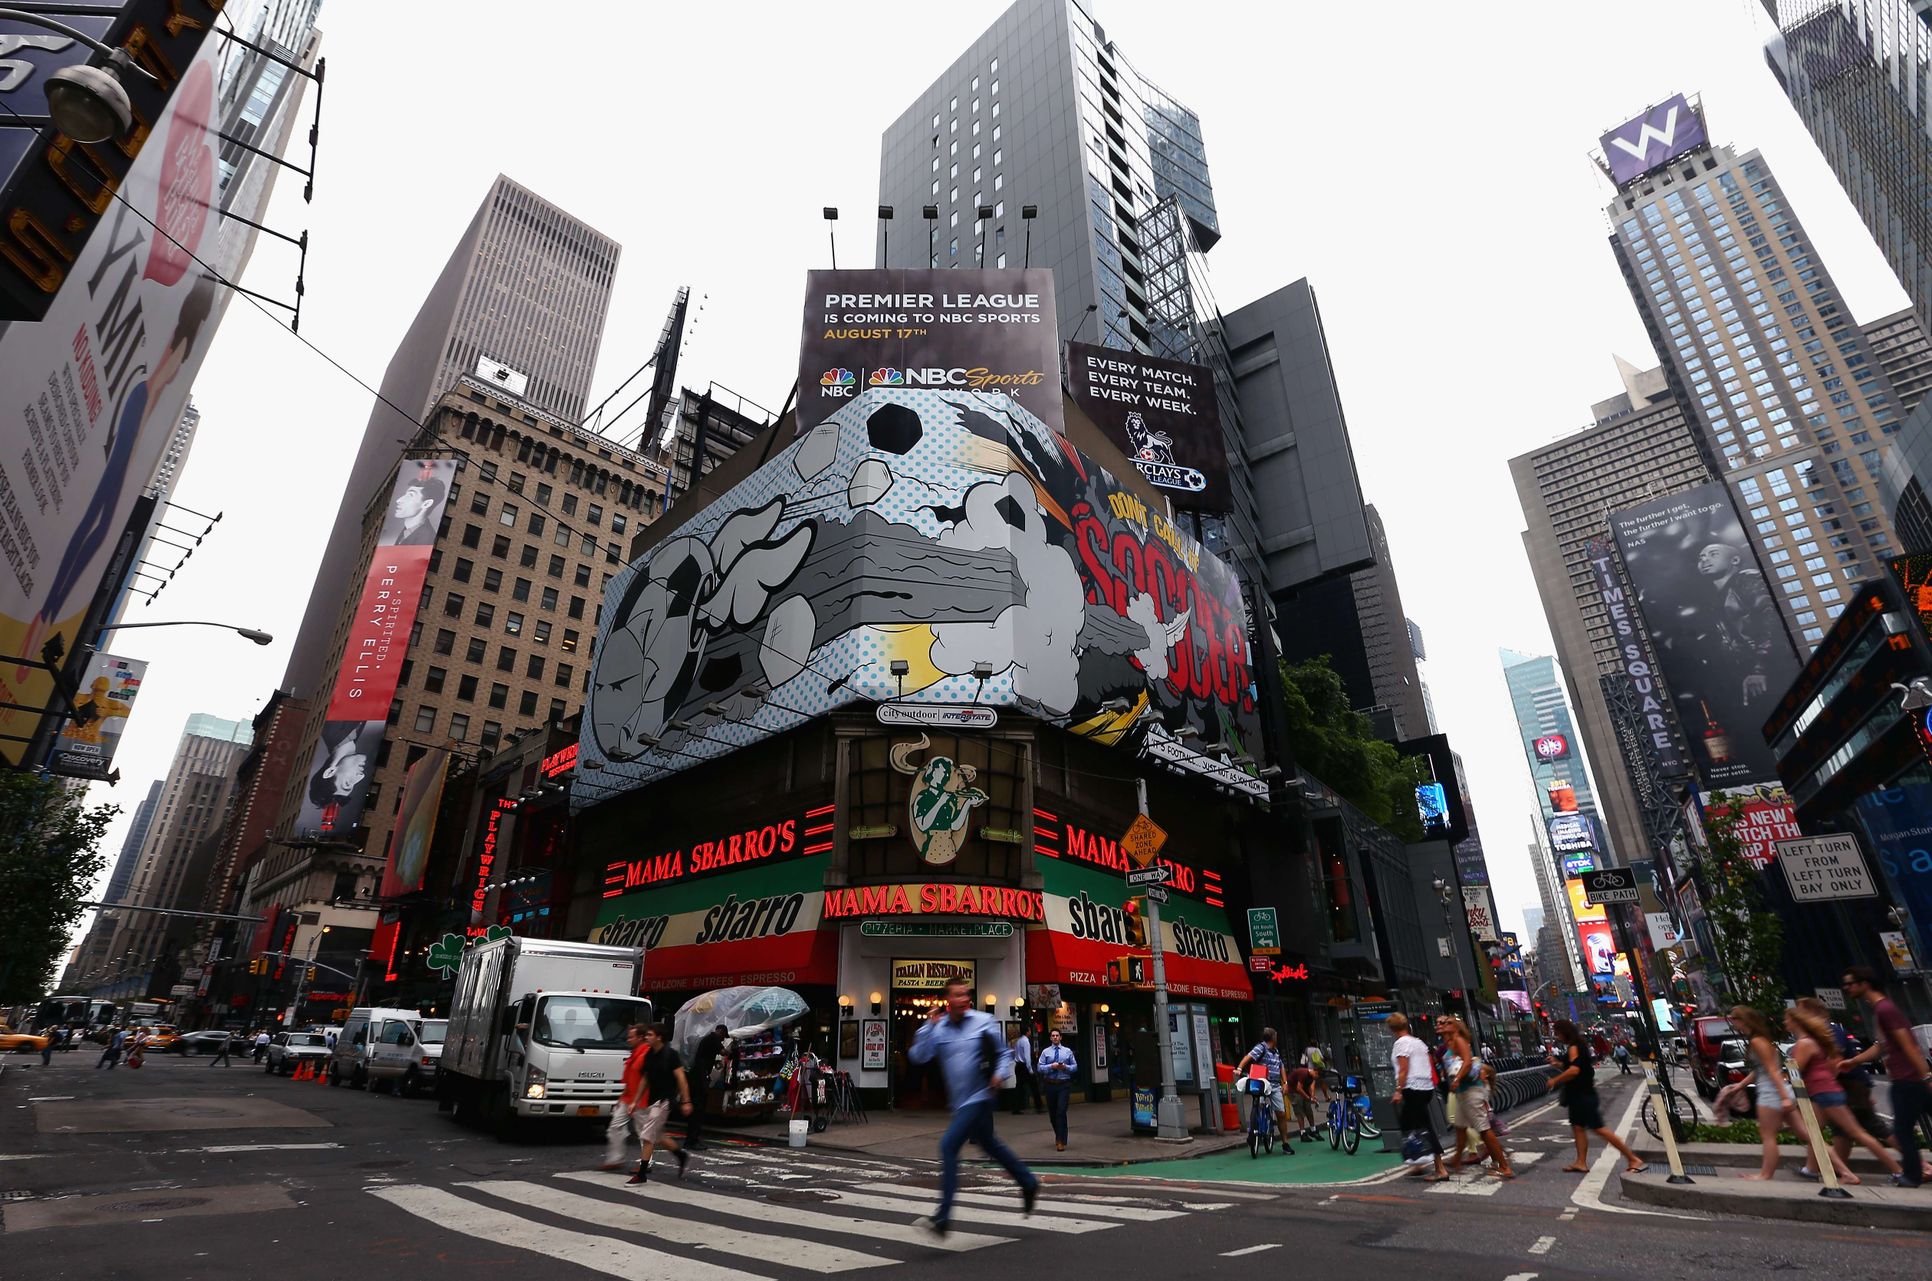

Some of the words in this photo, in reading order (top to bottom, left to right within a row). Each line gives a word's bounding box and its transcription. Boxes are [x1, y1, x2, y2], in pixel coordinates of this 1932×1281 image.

[1611, 105, 1678, 160] W
[825, 294, 934, 308] PREMIER
[943, 294, 1039, 308] LEAGUE
[825, 314, 838, 323] IS
[844, 314, 908, 323] COMING
[913, 314, 935, 323] TO
[940, 314, 973, 323] NBC
[978, 313, 1040, 323] SPORTS
[72, 321, 89, 362] NO
[824, 329, 892, 339] AUGUST
[897, 329, 927, 339] 17TH
[906, 368, 967, 385] NBC
[965, 367, 1044, 389] Sports
[1087, 356, 1137, 375] EVERY
[1142, 366, 1197, 386] MATCH.
[821, 386, 853, 397] NBC
[1088, 371, 1138, 389] EVERY
[1143, 381, 1191, 399] TEAM.
[1090, 386, 1140, 404] EVERY
[1146, 396, 1197, 415] WEEK.
[1136, 462, 1182, 479] RCLAYS
[1153, 475, 1182, 486] LEAGUE
[1618, 518, 1635, 529] The
[1636, 510, 1665, 525] further
[1672, 503, 1690, 513] get,
[1624, 527, 1638, 536] the
[1639, 518, 1668, 532] further
[1675, 510, 1697, 521] want
[1709, 502, 1724, 514] go.
[1108, 491, 1149, 531] DON'T
[1154, 514, 1185, 559] CALL
[1627, 538, 1647, 549] NAS
[370, 565, 397, 626] PERRY
[1593, 556, 1632, 636] TIMES
[1625, 644, 1672, 749] SQUARE
[349, 638, 376, 698] ELLIS
[883, 709, 900, 719] city
[902, 710, 937, 719] outdoor
[942, 712, 991, 722] INTERSTATE
[74, 744, 86, 752] NOW
[1202, 761, 1216, 771] JUST
[1230, 772, 1237, 782] AS
[1628, 752, 1651, 808] AMERICAN
[1749, 808, 1786, 826] NEW
[1130, 832, 1156, 841] SHARED
[1733, 825, 1773, 842] ATCH
[1880, 830, 1910, 841] Morgan
[1066, 824, 1130, 872] MAMA
[1134, 848, 1156, 856] AHEAD
[1136, 841, 1153, 849] ZONE
[1554, 840, 1593, 852] TOSHIBA
[1783, 845, 1813, 857] LEFT
[1817, 841, 1852, 853] TURN
[472, 810, 501, 912] PLAYWRIGH
[625, 851, 683, 888] MAMA
[690, 820, 796, 873] SBARRO'S
[1804, 856, 1839, 868] FROM
[1572, 859, 1592, 867] TDK
[1133, 874, 1145, 882] ONE
[1151, 871, 1164, 879] WAY
[1793, 870, 1822, 882] LEFT
[1827, 866, 1862, 878] TURN
[1590, 891, 1609, 901] BIKE
[1613, 890, 1636, 899] PATH
[1800, 883, 1823, 894] BAY
[1831, 880, 1863, 892] ONLY
[824, 885, 912, 919] MAMA
[921, 883, 1044, 922] SBARRO'S
[598, 915, 669, 951] sbarro
[696, 894, 804, 945] sbarro
[865, 923, 913, 935] PIZZERIA
[929, 924, 1010, 935] MARKETPLACE
[1068, 890, 1136, 947] sbar
[1172, 916, 1230, 964] sbarro
[896, 963, 925, 979] ITALIAN
[926, 963, 973, 980] RESTAURANT
[651, 978, 687, 990] CALZONE
[693, 976, 734, 988] ENTREES
[741, 971, 796, 985] ESPRESSO
[1070, 972, 1096, 984] PIZZA
[1166, 983, 1189, 993] ALZONE
[1193, 986, 1218, 996] ENTREES
[1221, 989, 1247, 999] ESPRESSO
[578, 1071, 605, 1079] ISUZU
